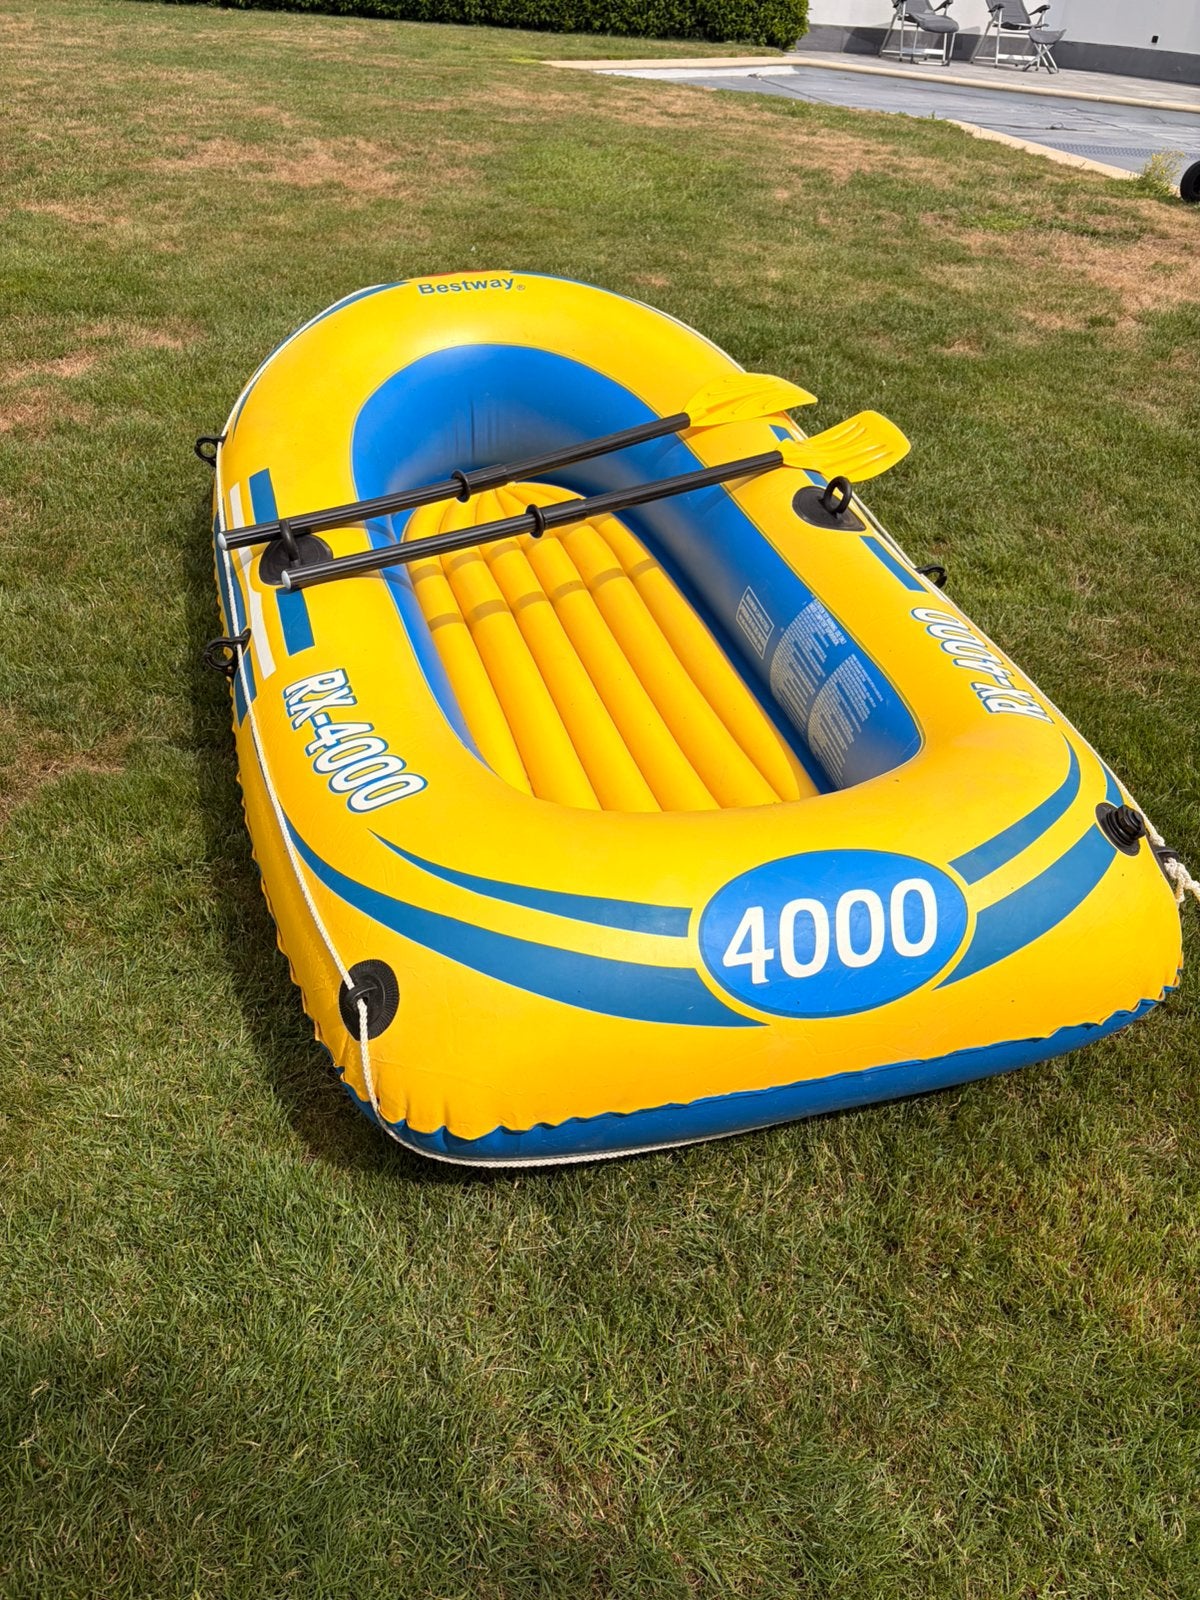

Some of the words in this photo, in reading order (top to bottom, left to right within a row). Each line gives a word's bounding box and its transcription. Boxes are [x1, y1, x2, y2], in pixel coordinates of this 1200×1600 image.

[910, 607, 1055, 724] RX-4000
[283, 668, 429, 813] RX-4000
[722, 878, 938, 984] 4000
